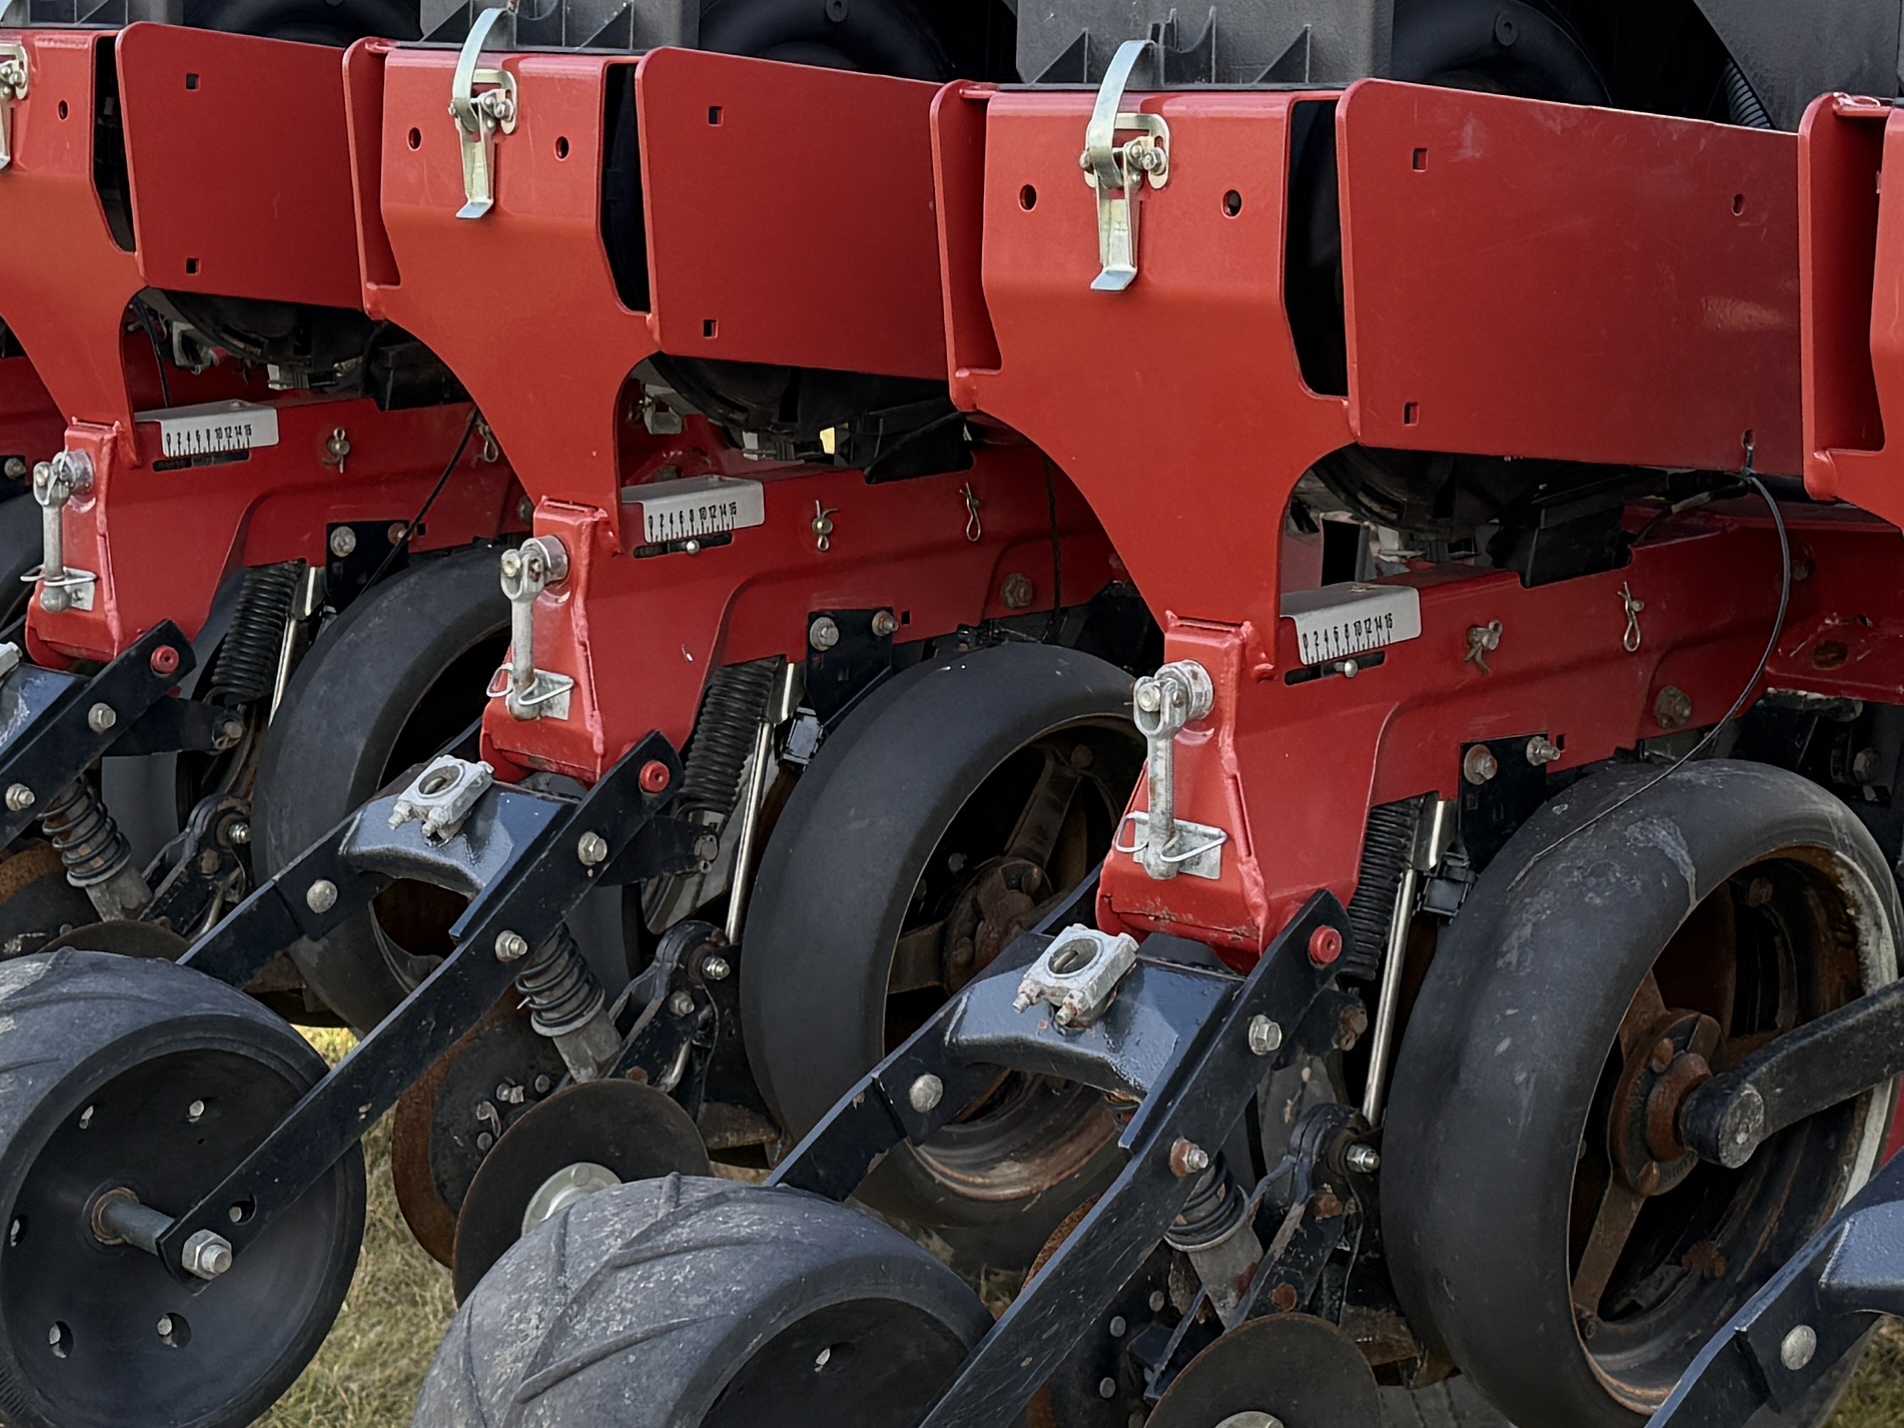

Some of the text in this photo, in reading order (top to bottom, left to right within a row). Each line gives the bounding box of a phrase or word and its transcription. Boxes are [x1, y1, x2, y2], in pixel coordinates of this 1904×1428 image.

[1313, 631, 1319, 647] 2
[1324, 628, 1328, 643] 4
[1354, 621, 1362, 636] 10
[1364, 618, 1372, 633] 12
[1375, 616, 1383, 631] 14
